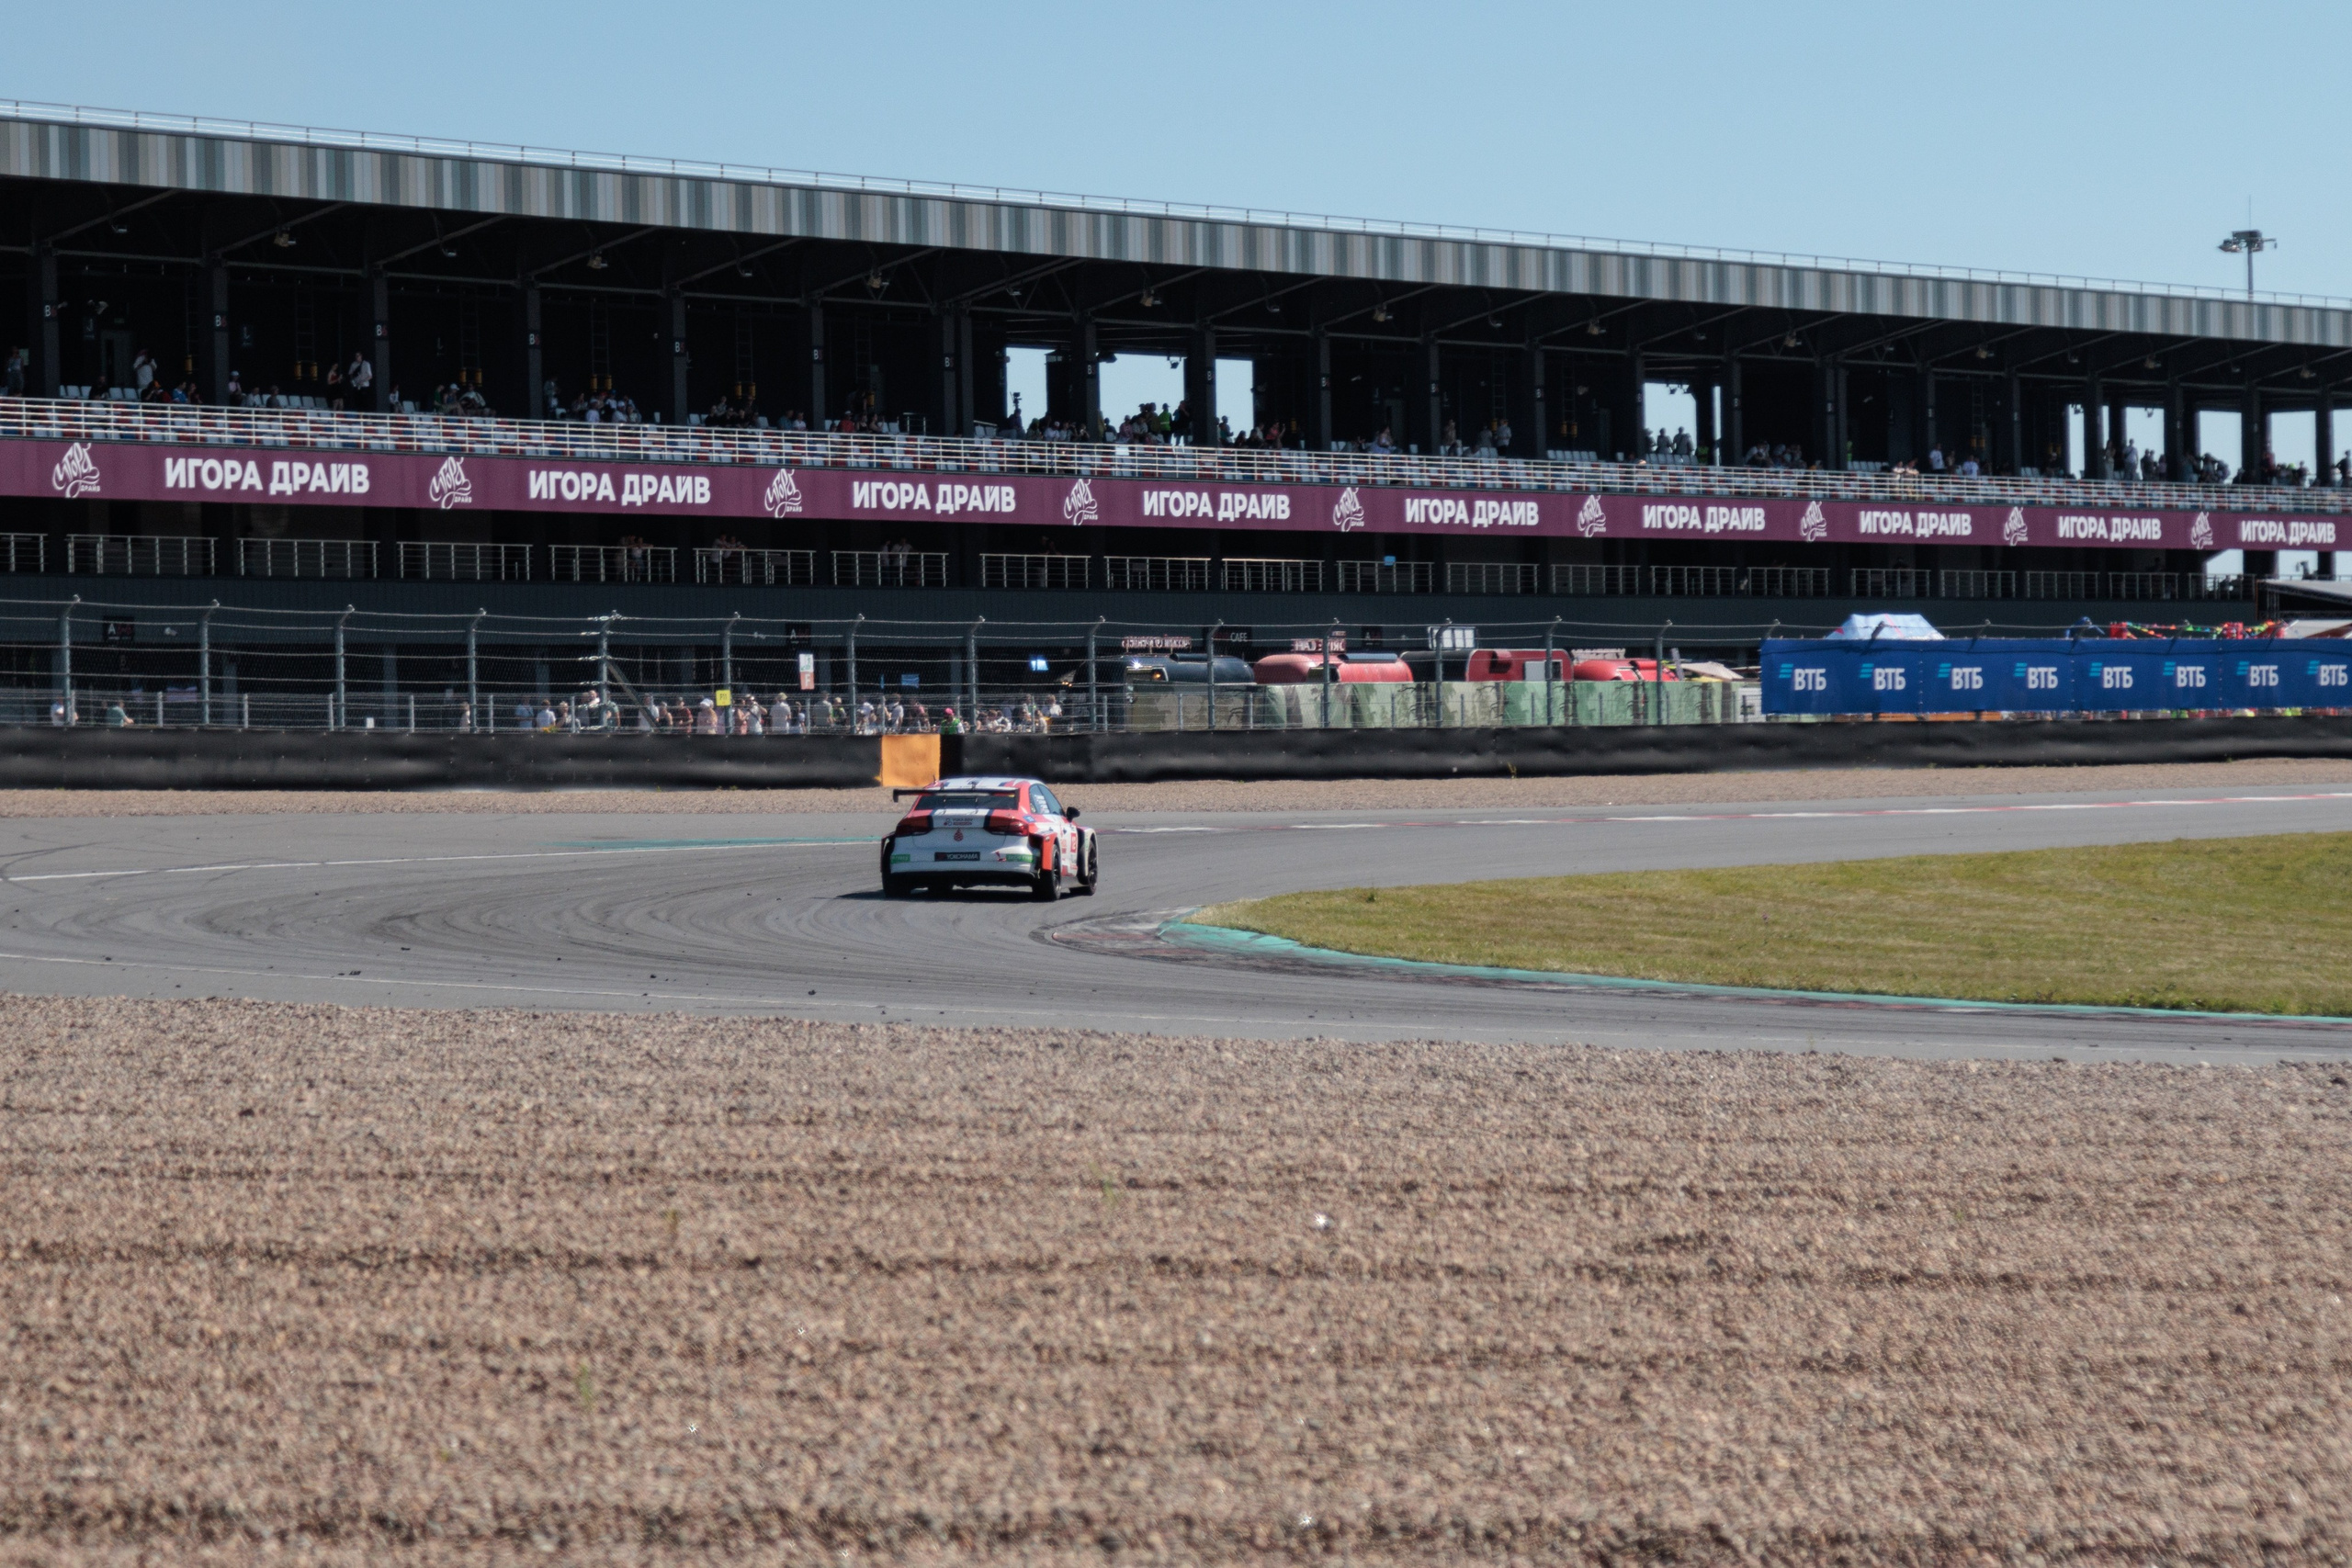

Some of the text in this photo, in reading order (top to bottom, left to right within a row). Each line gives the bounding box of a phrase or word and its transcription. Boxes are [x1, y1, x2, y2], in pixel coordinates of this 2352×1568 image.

[164, 457, 370, 496] ИГОРА ДРАЙВ
[528, 469, 711, 507] ИГОРА ДРАЙВ
[853, 480, 1016, 515] ИГОРА ДРАЙВ
[1143, 490, 1291, 523] ИГОРА ДРАЙВ
[1405, 498, 1540, 528] ИГОРА ДРАЙВ
[1643, 504, 1766, 533] ИГОРА ДРАЙВ
[1860, 510, 1973, 538] ИГОРА ДРАЙВ
[2058, 515, 2162, 542] ИГОРА ДРАЙВ
[2240, 520, 2336, 546] ИГОРА ДРАЙВ
[1230, 632, 1248, 642] CAFE
[1794, 668, 1826, 691] ВТБ
[1874, 668, 1906, 690] ВТБ
[1951, 667, 1984, 690] ВТБ
[2028, 667, 2058, 689] ВТБ
[2103, 666, 2133, 689] ВТБ
[2177, 666, 2206, 687] ВТБ
[2250, 665, 2278, 686] ВТБ
[2320, 664, 2347, 686] ВТБ
